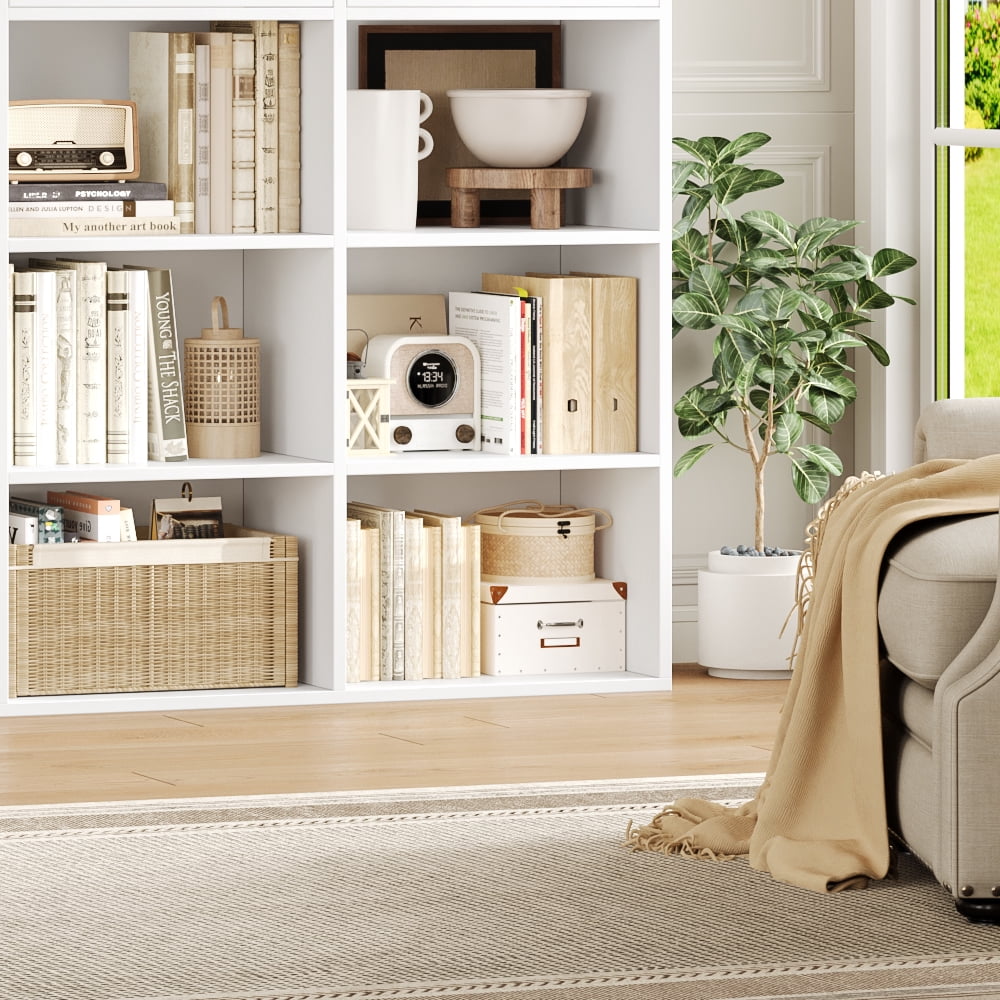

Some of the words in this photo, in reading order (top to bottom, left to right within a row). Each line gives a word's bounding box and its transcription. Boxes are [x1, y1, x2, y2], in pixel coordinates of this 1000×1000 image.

[63, 222, 80, 232] My
[84, 222, 127, 231] another
[130, 222, 146, 231] art
[150, 222, 177, 231] book
[155, 292, 173, 340] YOUNG
[159, 351, 176, 378] THE
[163, 379, 181, 423] SHACK
